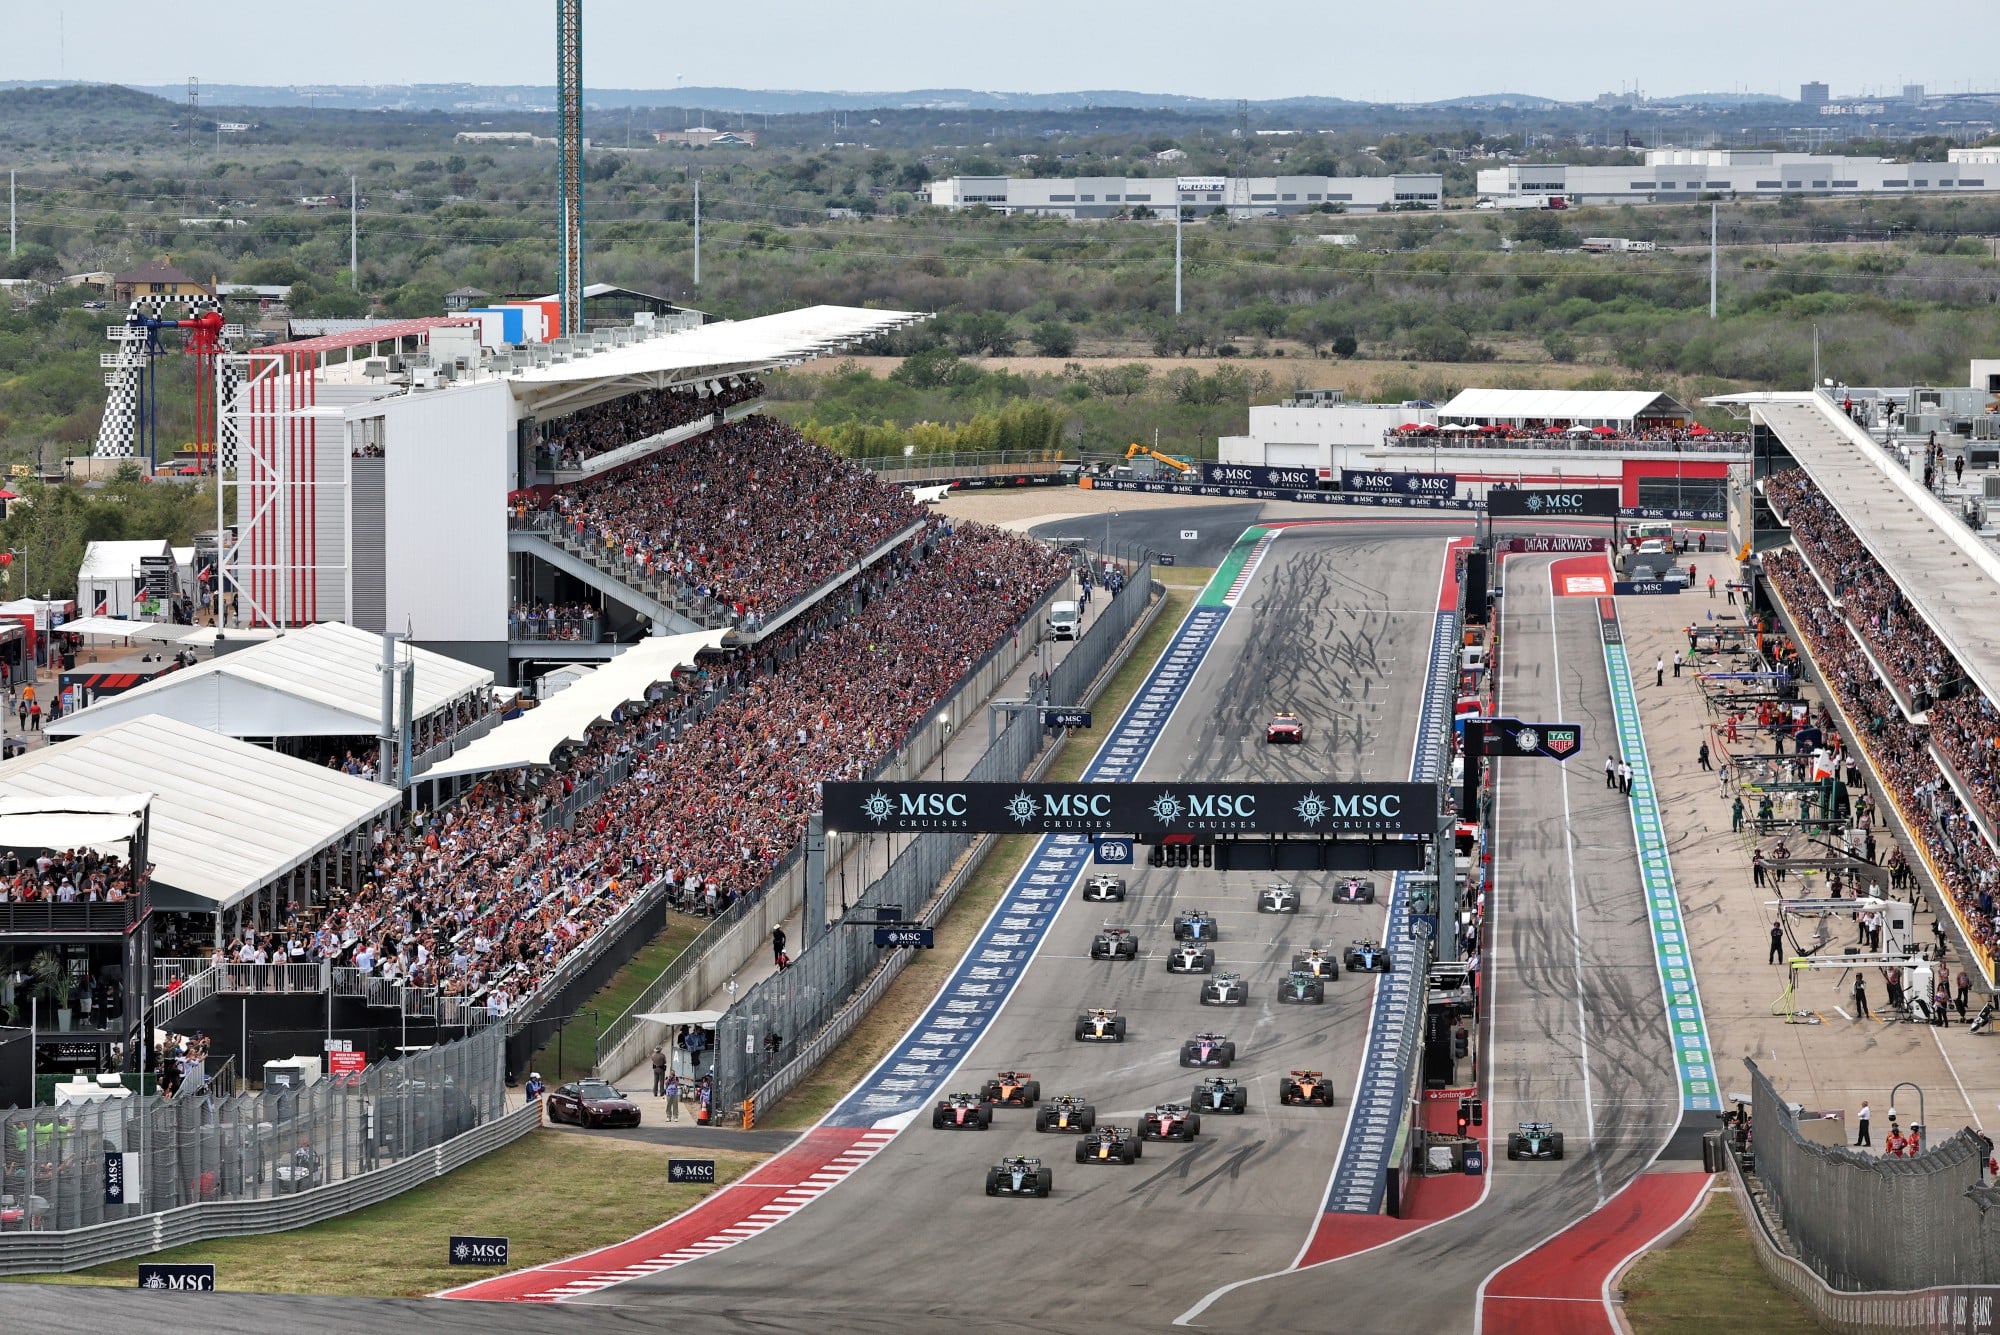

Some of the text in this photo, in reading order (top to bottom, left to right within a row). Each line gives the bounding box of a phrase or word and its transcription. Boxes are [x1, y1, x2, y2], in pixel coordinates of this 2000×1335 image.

[1225, 468, 1252, 480] MSC
[1282, 472, 1308, 483] MSC
[1365, 475, 1393, 486] MSC
[1421, 478, 1448, 489] MSC
[1545, 494, 1583, 507] MSC
[1524, 538, 1592, 552] QATAR AIRWAYS
[899, 793, 967, 816] MSC
[1043, 794, 1111, 817] MSC
[1187, 794, 1256, 817] MSC
[1332, 794, 1401, 817] MSC
[899, 819, 967, 827] CRUISES
[1043, 820, 1111, 828] CRUISES
[1187, 820, 1256, 829] CRUISES
[1332, 820, 1401, 829] CRUISES
[1101, 844, 1126, 858] FIA
[900, 932, 921, 940] MSC
[673, 1050, 679, 1063] A
[1466, 1159, 1480, 1167] FIA
[108, 1158, 118, 1184] MSC
[686, 1165, 713, 1176] MSC
[472, 1244, 506, 1257] MSC
[167, 1274, 211, 1292] MSC
[1979, 1295, 1993, 1327] MSC
